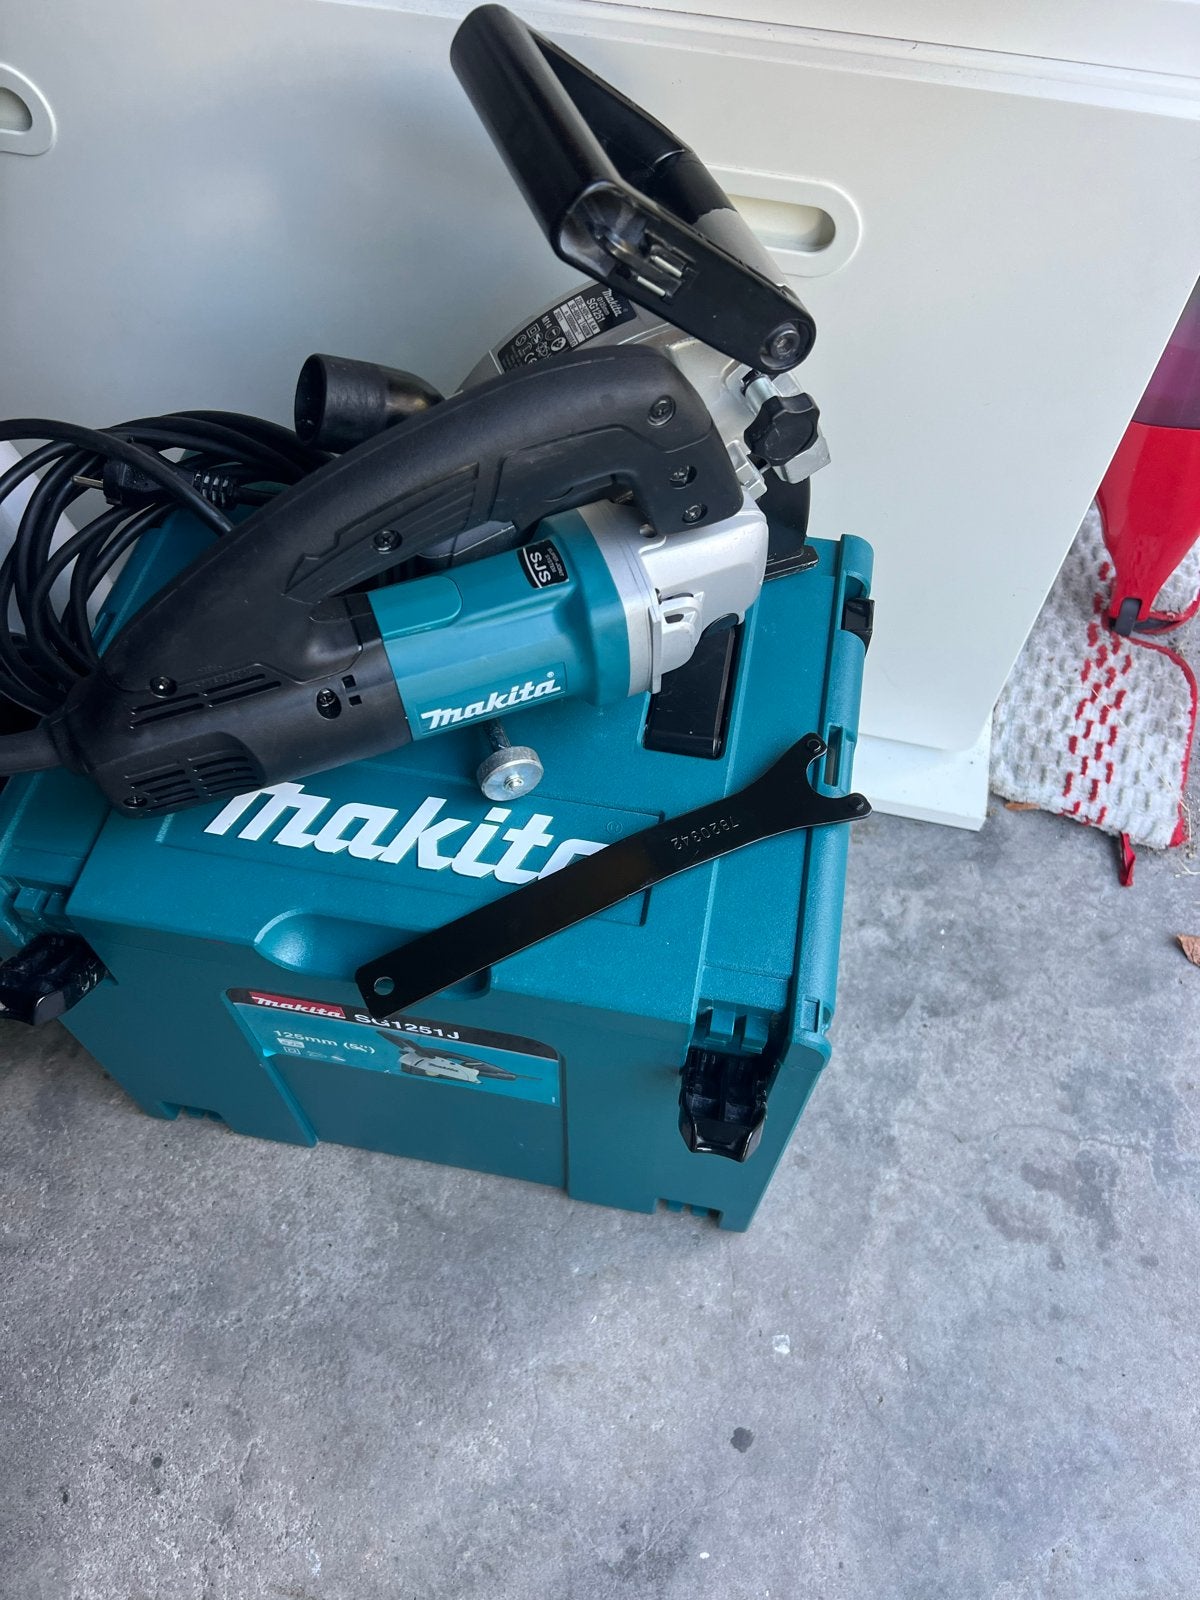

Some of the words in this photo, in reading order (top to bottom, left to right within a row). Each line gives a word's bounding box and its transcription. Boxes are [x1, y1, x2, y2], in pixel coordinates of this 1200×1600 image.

[541, 315, 552, 328] M14
[586, 297, 604, 323] SG1251
[530, 551, 551, 583] SJS
[671, 816, 740, 850] 7820342
[273, 1030, 338, 1047] 125mm
[354, 1014, 460, 1040] SG1251J
